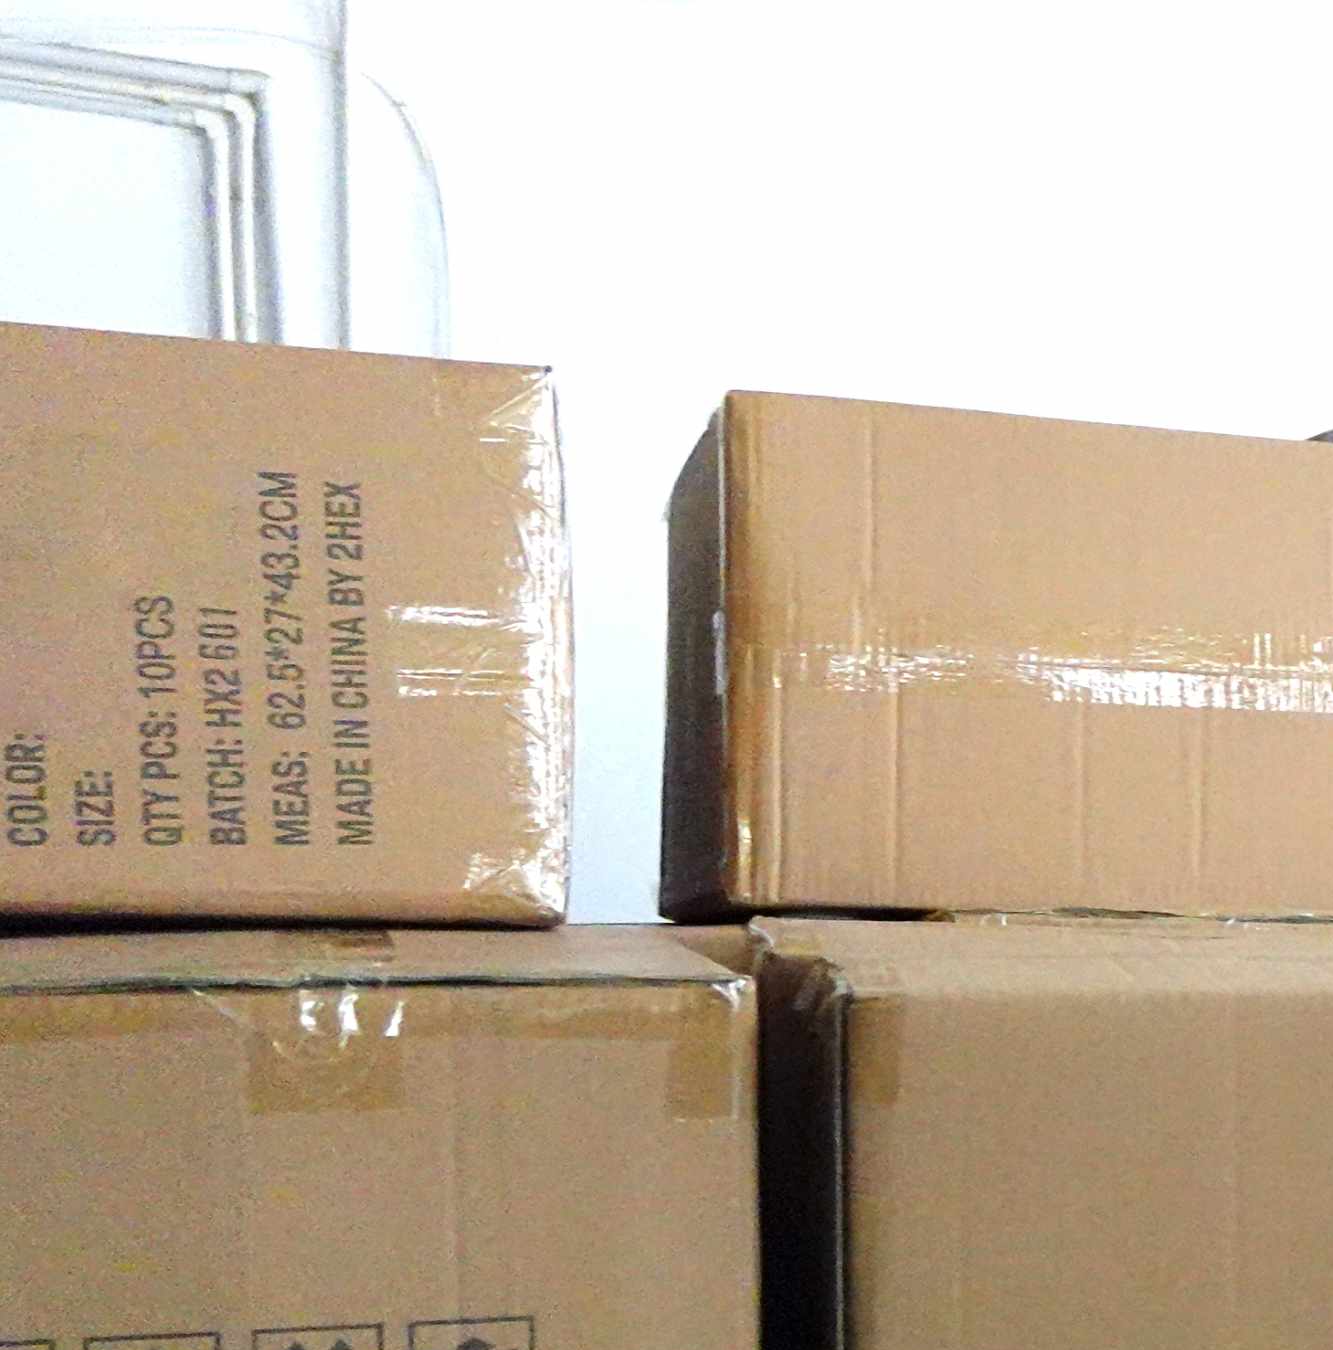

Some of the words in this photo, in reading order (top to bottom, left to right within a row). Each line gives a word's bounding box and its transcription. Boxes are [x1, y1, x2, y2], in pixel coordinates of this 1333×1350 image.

[323, 480, 362, 561] 2HEX
[326, 569, 364, 606] BY
[134, 594, 177, 699] 10PCS
[329, 616, 370, 709] CHINA
[139, 711, 181, 780] PCS:
[332, 719, 370, 748] IN
[5, 733, 48, 847] COLOR:
[74, 771, 116, 847] SIZE:
[142, 788, 183, 846] QTY
[205, 738, 247, 846] BATCH:
[271, 751, 310, 846] MEAS:
[334, 758, 374, 846] MADE
